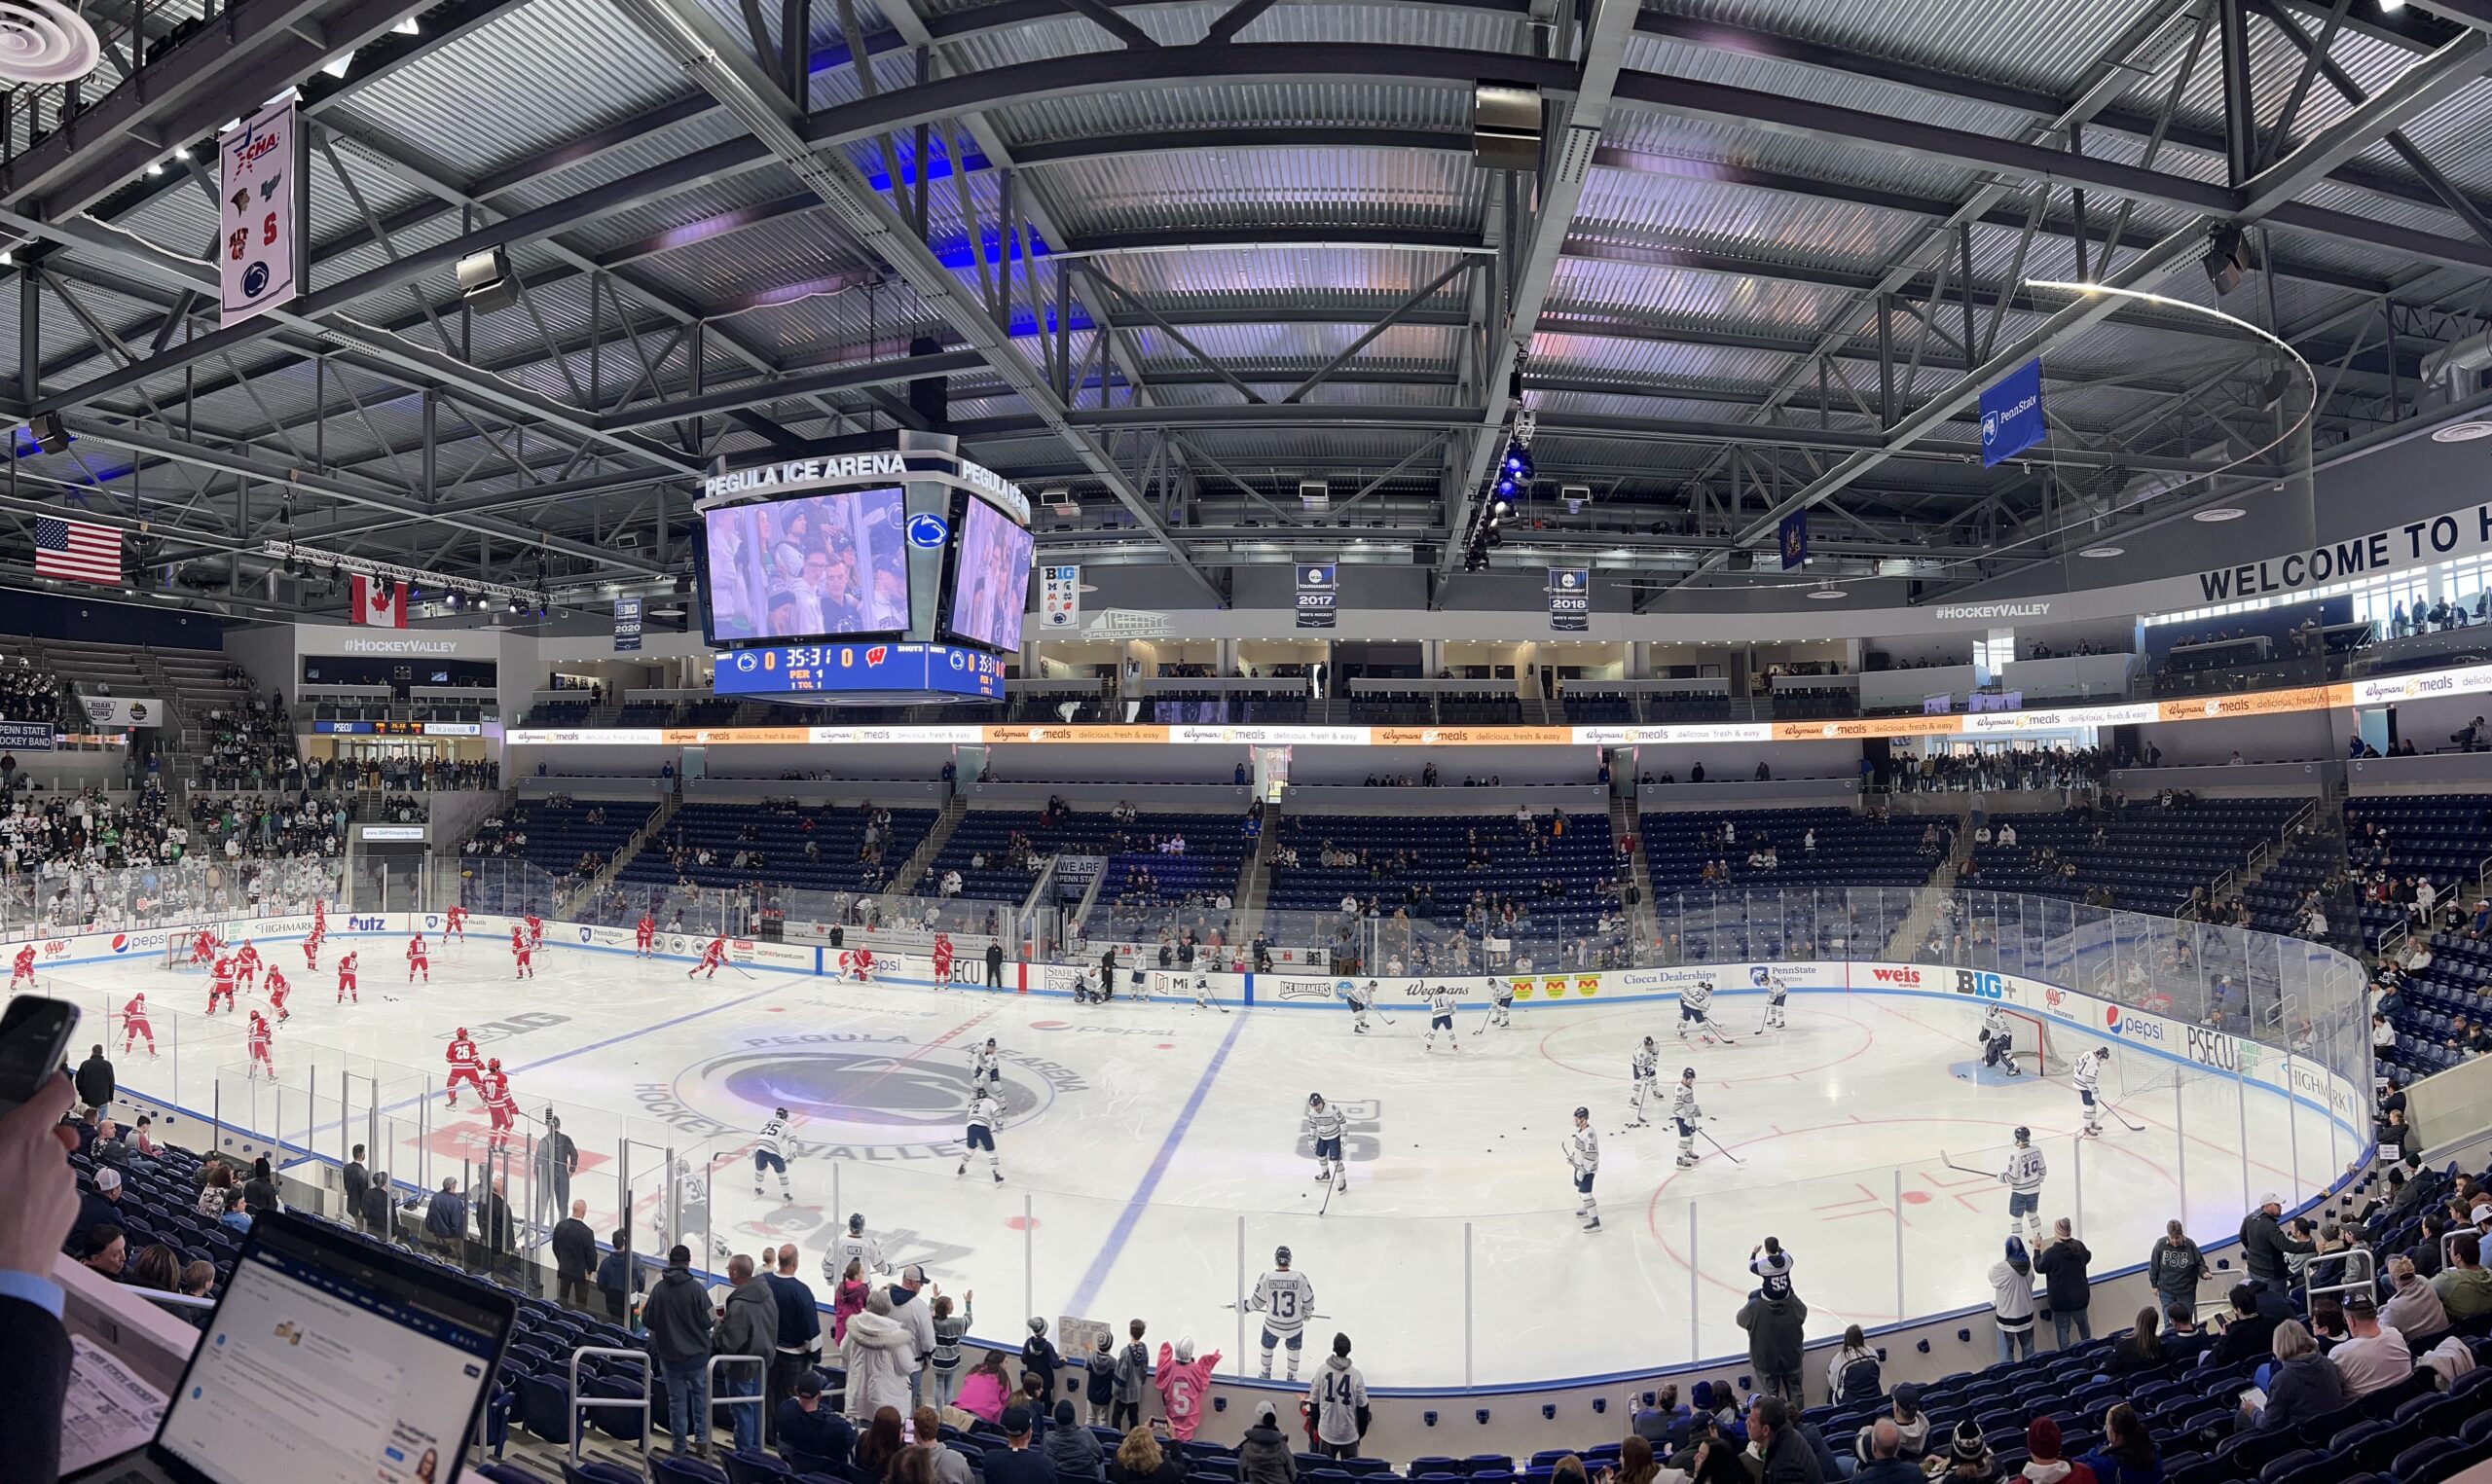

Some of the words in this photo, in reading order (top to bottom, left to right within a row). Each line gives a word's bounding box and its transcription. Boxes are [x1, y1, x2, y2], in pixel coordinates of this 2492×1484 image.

[705, 467, 778, 498] PEGULA
[783, 461, 825, 485] ICE
[824, 453, 907, 479] ARENA
[962, 459, 1008, 499] PEGULA
[2200, 533, 2390, 601] WELCOME
[2404, 516, 2459, 559] TO
[1299, 596, 1333, 605] 2017
[1552, 599, 1587, 609] 2018
[614, 624, 641, 633] 2020
[1093, 630, 1129, 638] PEGULA
[764, 651, 776, 670] 0
[786, 648, 832, 668] 35:31
[841, 647, 854, 668] 0
[789, 670, 810, 679] PER
[816, 670, 824, 678] 1
[2365, 683, 2404, 701] Wegmans
[2420, 676, 2453, 692] meals
[2168, 703, 2205, 718] Wegmans
[2218, 700, 2250, 712] meals
[2327, 693, 2343, 704] easy
[1977, 715, 2014, 729] Wegmans
[2030, 713, 2060, 725] meals
[2107, 711, 2124, 720] fresh
[2132, 711, 2147, 720] easy
[22, 727, 46, 736] STATE
[333, 723, 352, 732] PSECU
[1784, 724, 1823, 738] Wegmans
[1838, 723, 1867, 734] meals
[1937, 722, 1954, 732] easy
[28, 736, 51, 746] BAND
[863, 730, 890, 740] meals
[994, 730, 1028, 741] Wegmans
[1043, 730, 1071, 739] meals
[1184, 729, 1221, 742] Wegmans
[1235, 730, 1265, 740] meals
[1383, 730, 1422, 742] Wegmans
[1438, 730, 1468, 741] meals
[1476, 732, 1511, 741] delicious,
[1586, 729, 1623, 742] Wegmans
[1638, 729, 1668, 739] meals
[1743, 730, 1760, 739] easy
[1060, 861, 1077, 872] WE
[1079, 862, 1100, 873] ARE
[1059, 875, 1079, 884] PENN
[261, 922, 313, 934] HIGHMARK
[593, 928, 623, 937] PennState
[132, 931, 168, 950] pepsi
[416, 942, 424, 953] 16
[756, 950, 805, 959] NOPAYbryant.com
[224, 964, 234, 974] 35
[873, 959, 901, 972] epsi
[948, 959, 980, 984] SECU
[1772, 966, 1816, 975] PennState
[1624, 974, 1658, 985] Ciocca
[1660, 970, 1716, 985] Dealerships
[1873, 966, 1921, 983] weis
[1173, 978, 1189, 989] Mi
[1281, 981, 1295, 995] ICE
[1294, 982, 1331, 995] BREAKERS
[1406, 979, 1470, 1003] Wegans
[1694, 991, 1705, 1004] 23
[1434, 997, 1445, 1008] 11
[2053, 1008, 2074, 1021] Insurance
[1078, 1025, 1176, 1037] pepsi
[2125, 1016, 2164, 1041] pepsi
[744, 1032, 912, 1048] PEGULA
[456, 1045, 470, 1060] 26
[2187, 1026, 2235, 1071] PSECU
[634, 1082, 742, 1141] HOCKEY
[759, 1123, 779, 1137] 25
[796, 1139, 970, 1161] VALLE
[1588, 1142, 1596, 1151] 26
[2162, 1249, 2188, 1268] PSU
[1271, 1290, 1296, 1318] 13
[1324, 1371, 1352, 1405] 14
[1172, 1382, 1191, 1415] 5
